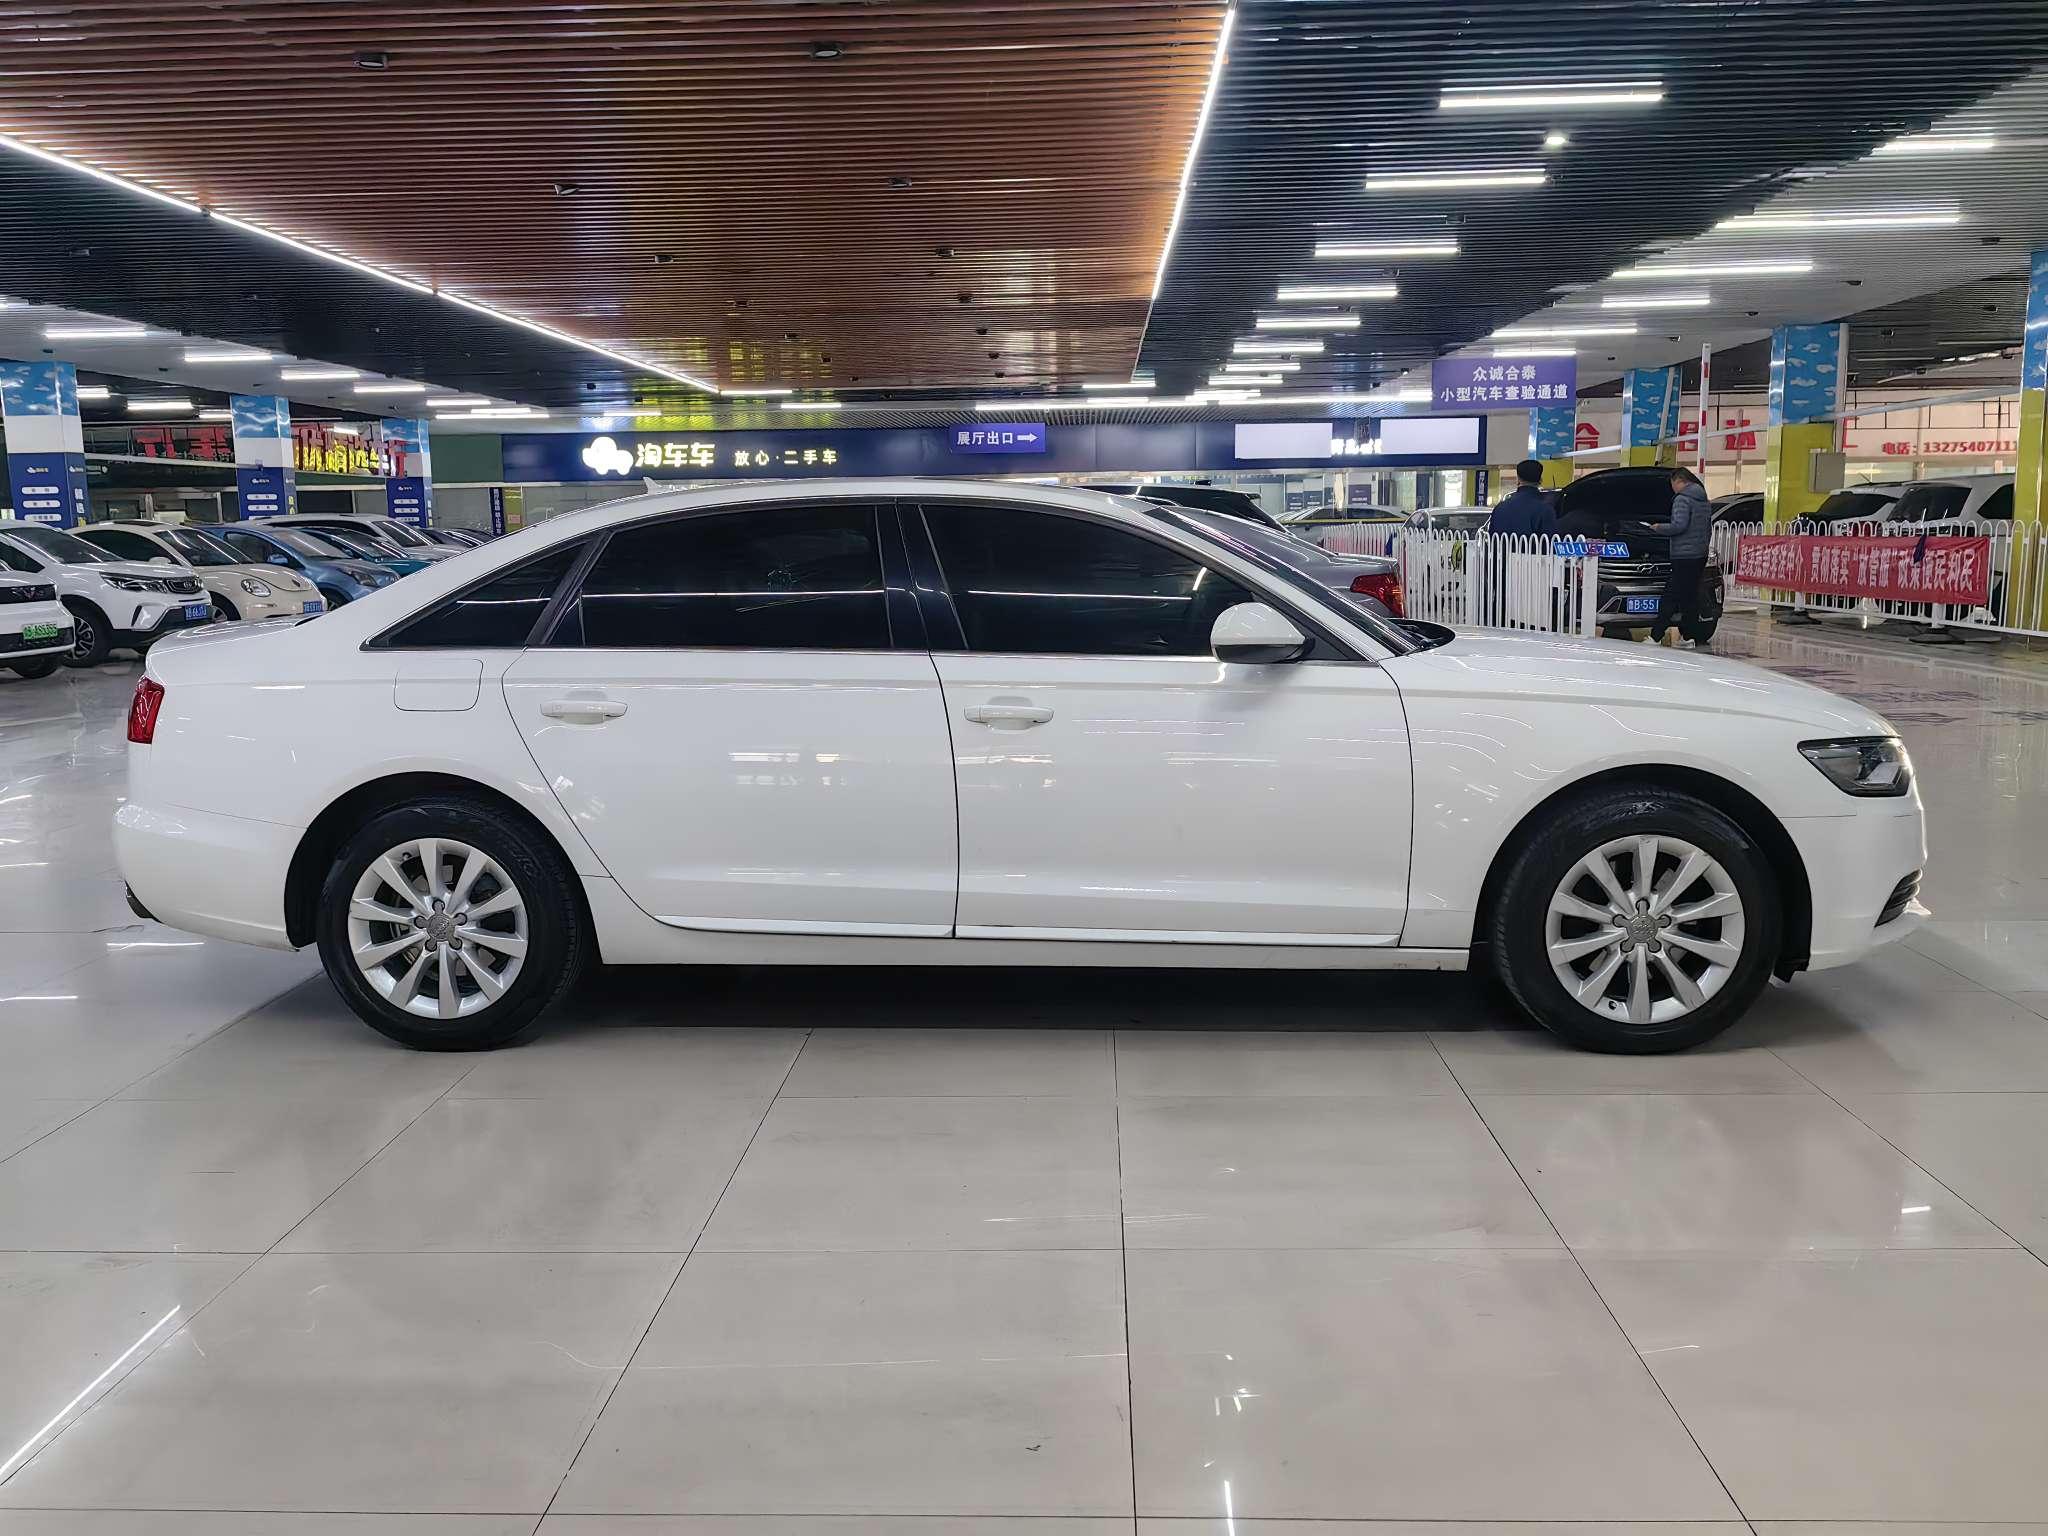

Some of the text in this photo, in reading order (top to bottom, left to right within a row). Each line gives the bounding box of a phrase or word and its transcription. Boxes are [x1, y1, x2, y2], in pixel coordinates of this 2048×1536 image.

[1472, 365, 1536, 381] 众诚合泰
[1440, 384, 1568, 402] 小型汽车查验通道
[957, 431, 1013, 445] 展厅出口
[634, 442, 715, 467] 淘车车
